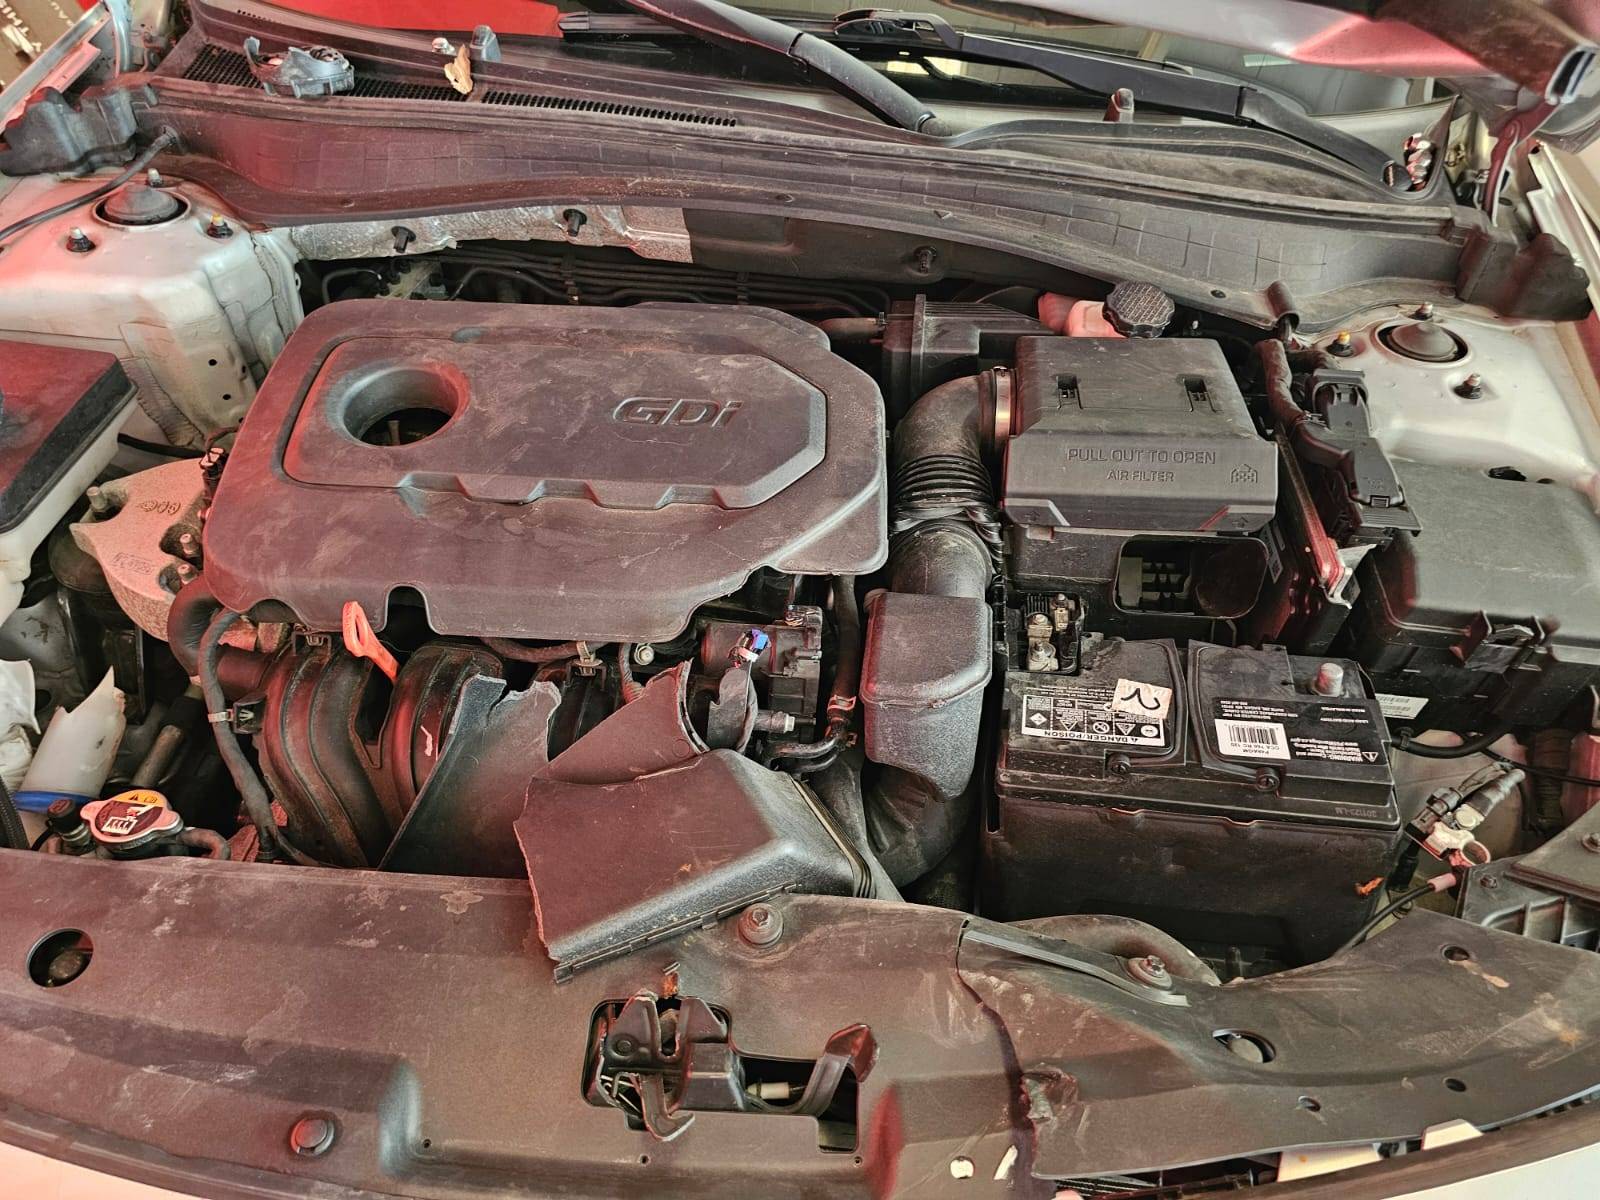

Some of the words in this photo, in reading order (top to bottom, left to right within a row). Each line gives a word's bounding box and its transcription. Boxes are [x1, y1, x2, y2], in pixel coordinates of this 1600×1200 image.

[1067, 448, 1108, 463] PULL
[1110, 449, 1143, 464] OUT
[1149, 450, 1168, 464] TO
[1172, 451, 1216, 465] OPEN
[1106, 470, 1129, 482] AIR
[1131, 470, 1175, 483] FILTER
